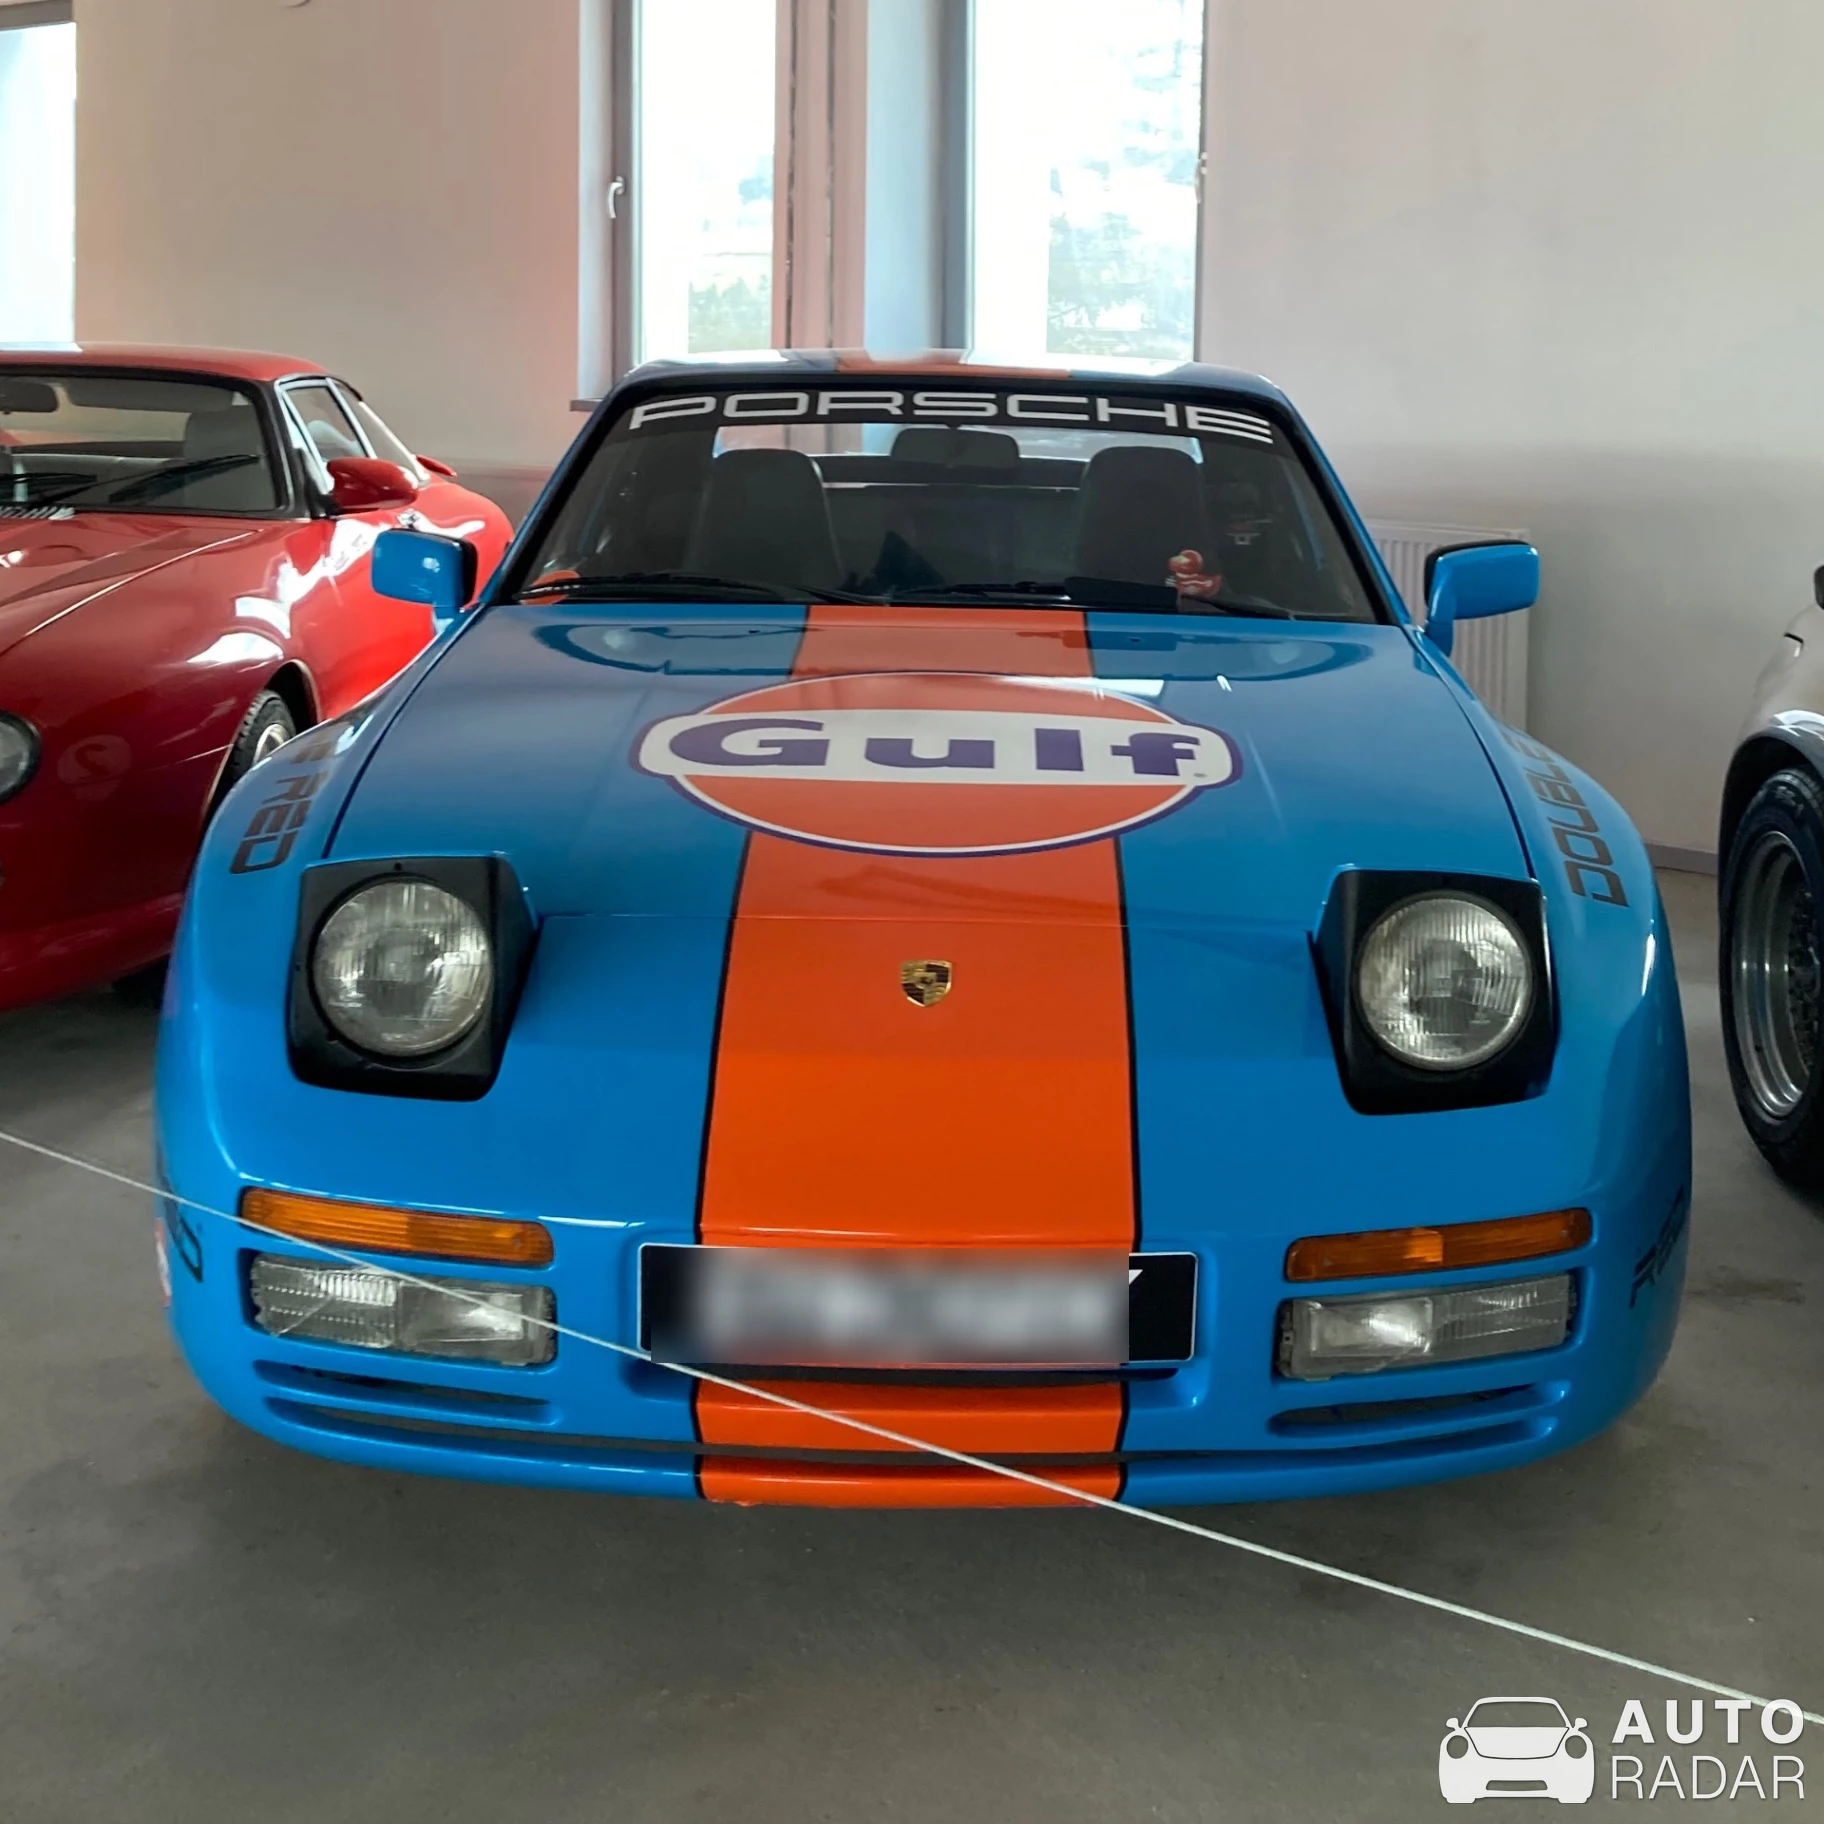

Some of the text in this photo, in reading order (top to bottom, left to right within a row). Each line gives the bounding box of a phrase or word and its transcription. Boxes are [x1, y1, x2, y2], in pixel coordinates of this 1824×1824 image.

[629, 391, 1274, 445] PORSCHE
[668, 717, 1201, 777] Gulf
[229, 770, 329, 875] RED
[1502, 731, 1630, 908] DOUBLE
